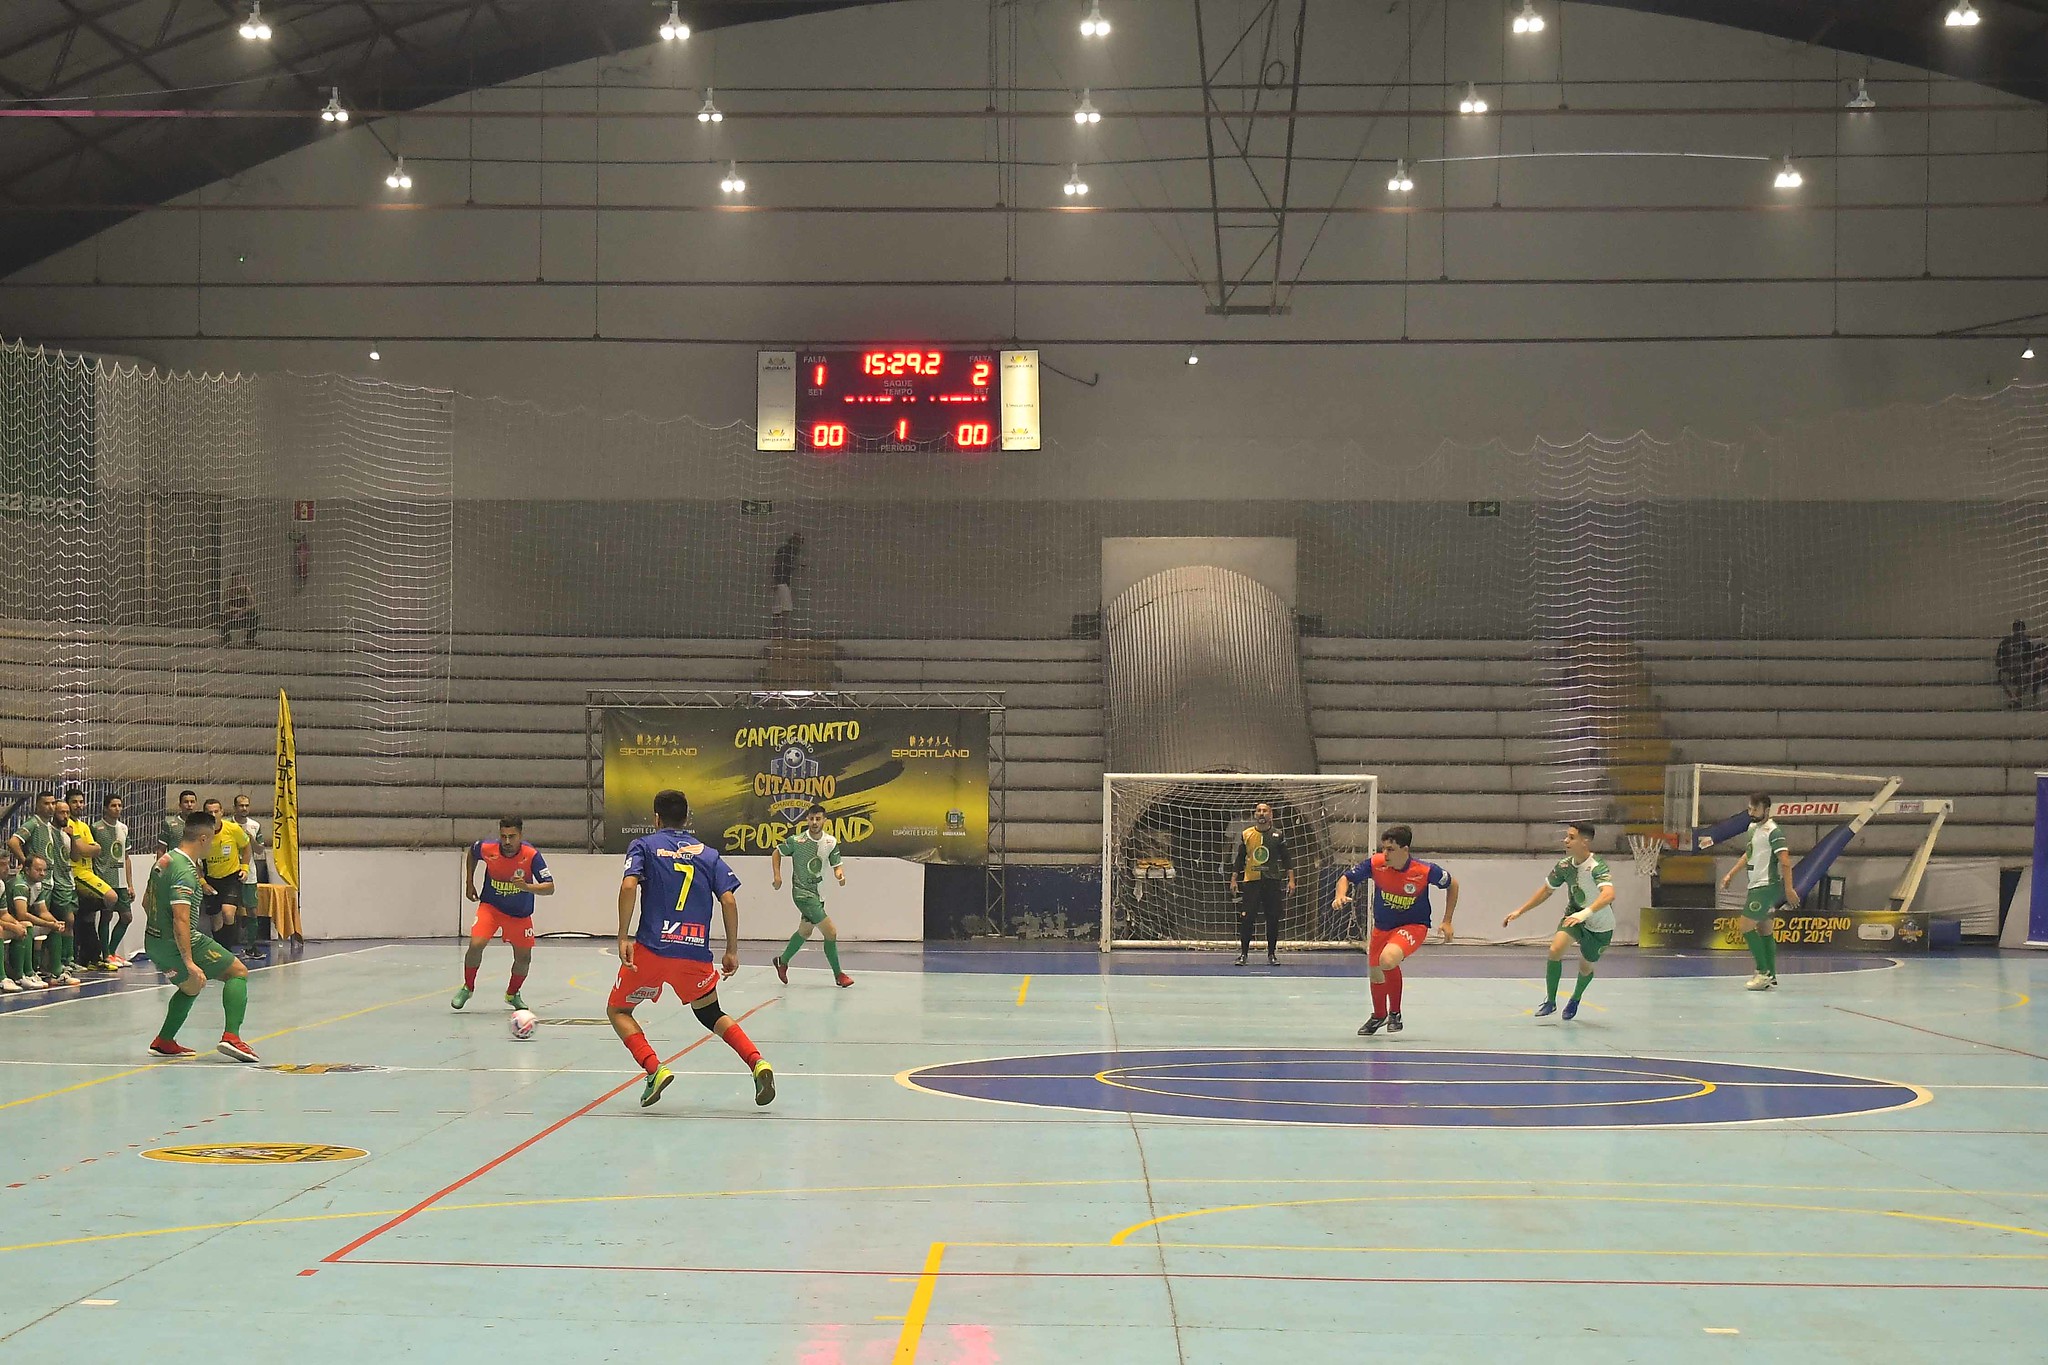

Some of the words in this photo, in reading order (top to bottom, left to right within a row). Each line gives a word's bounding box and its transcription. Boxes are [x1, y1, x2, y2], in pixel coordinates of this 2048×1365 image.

[864, 353, 940, 375] 15:29.2
[816, 367, 824, 386] 1
[972, 364, 989, 385] 2
[813, 425, 844, 446] 00
[899, 420, 906, 440] 1
[957, 424, 988, 446] 00
[735, 720, 860, 749] CAMPEONATO
[619, 747, 698, 757] SPORTLAND
[891, 749, 970, 758] SPORTLAND
[753, 772, 836, 799] CITADINO
[773, 801, 795, 810] CHAVE
[795, 800, 811, 809] OUR
[1776, 803, 1840, 815] RAPINI
[673, 862, 695, 911] 7
[1788, 917, 1851, 930] CITADINO
[1803, 931, 1833, 943] 2019
